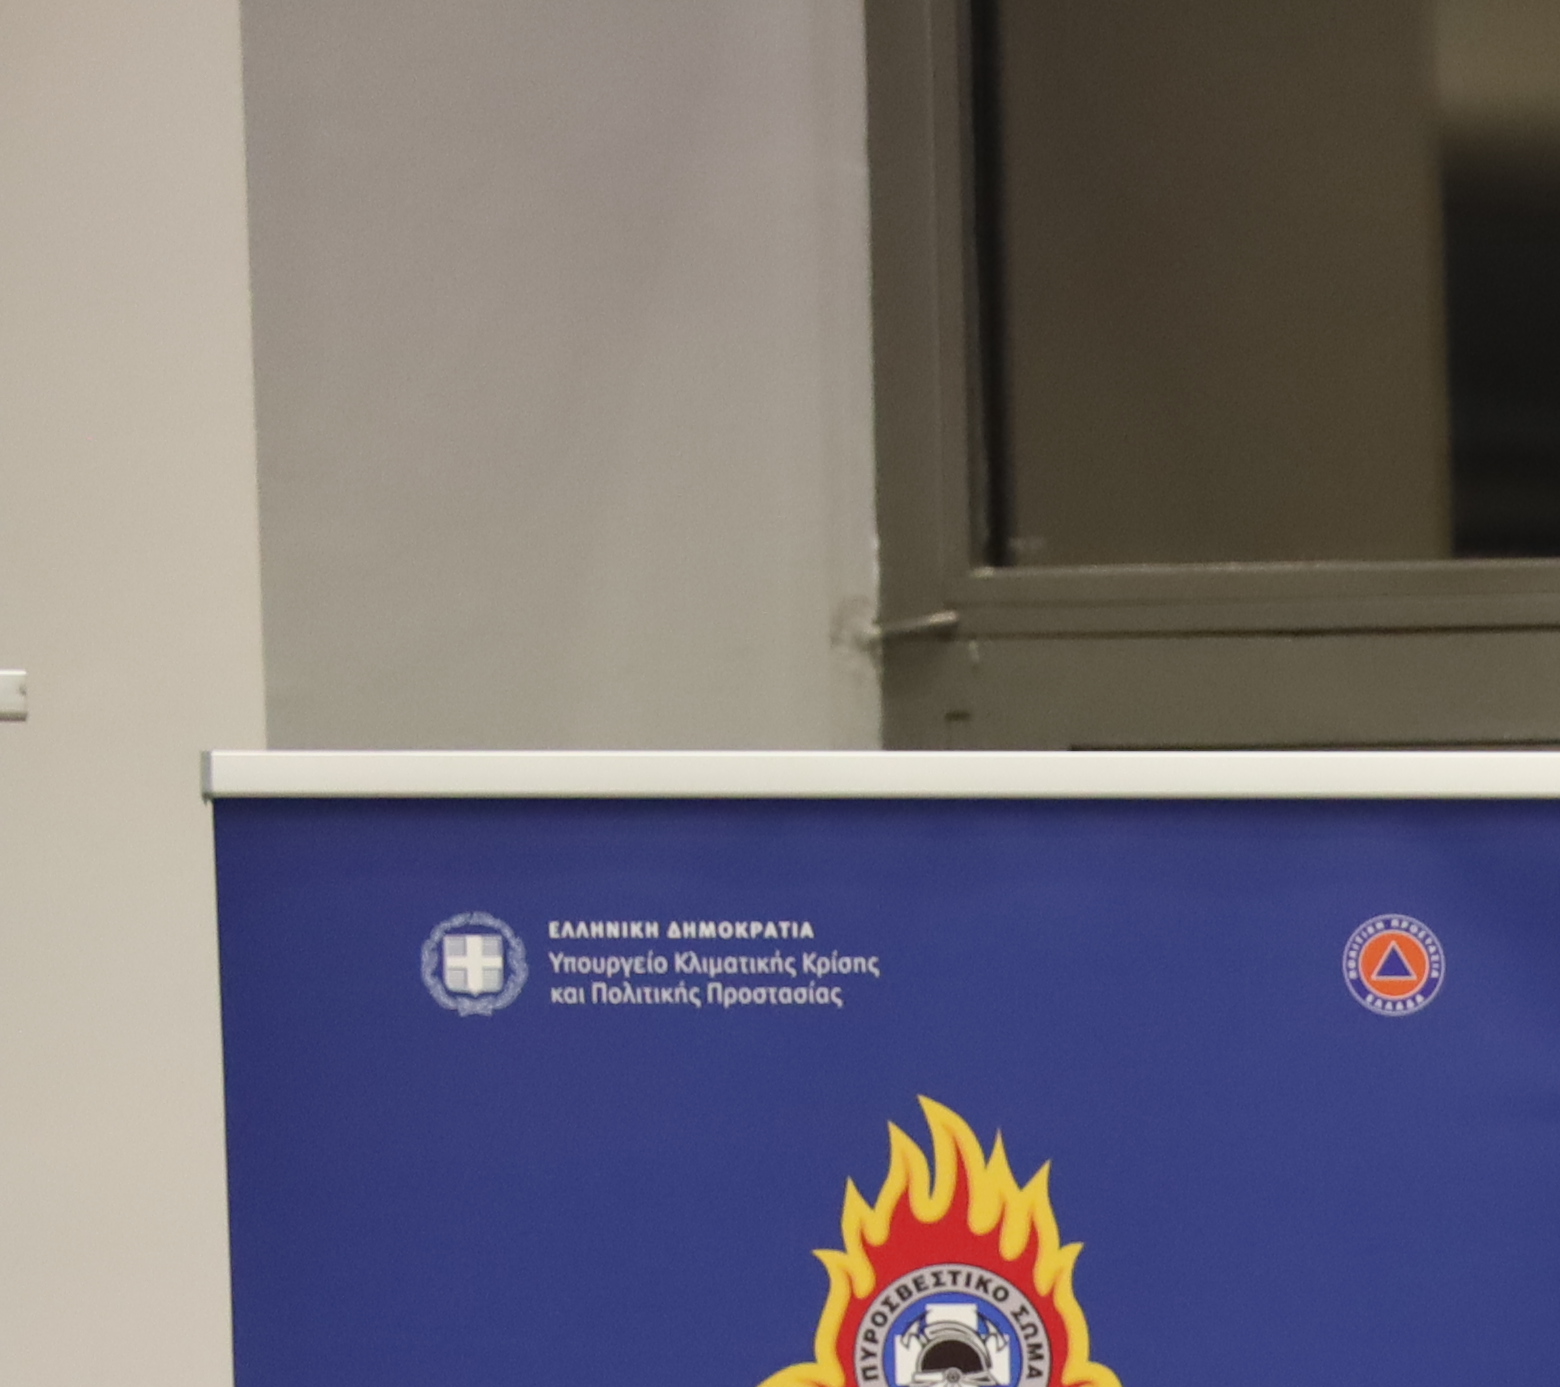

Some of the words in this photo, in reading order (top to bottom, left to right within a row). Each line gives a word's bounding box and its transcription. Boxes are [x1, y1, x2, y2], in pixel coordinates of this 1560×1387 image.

[548, 920, 659, 939] ΕΛΛΗΝΙΚΗ
[667, 920, 814, 939] ΔΗΜΟΚΡΑΤΙΑ
[548, 950, 668, 978] Υπουργείο
[674, 950, 797, 978] Κλιματικής
[802, 950, 880, 978] Κρίσης
[550, 985, 585, 1005] και
[591, 981, 702, 1008] Πολιτικής
[707, 981, 843, 1009] Προστασίας
[860, 1269, 1010, 1381] ΠΥΡΟΣΒΕΣΤΙΚΟ
[1010, 1304, 1045, 1380] ΣΩΜΑ
